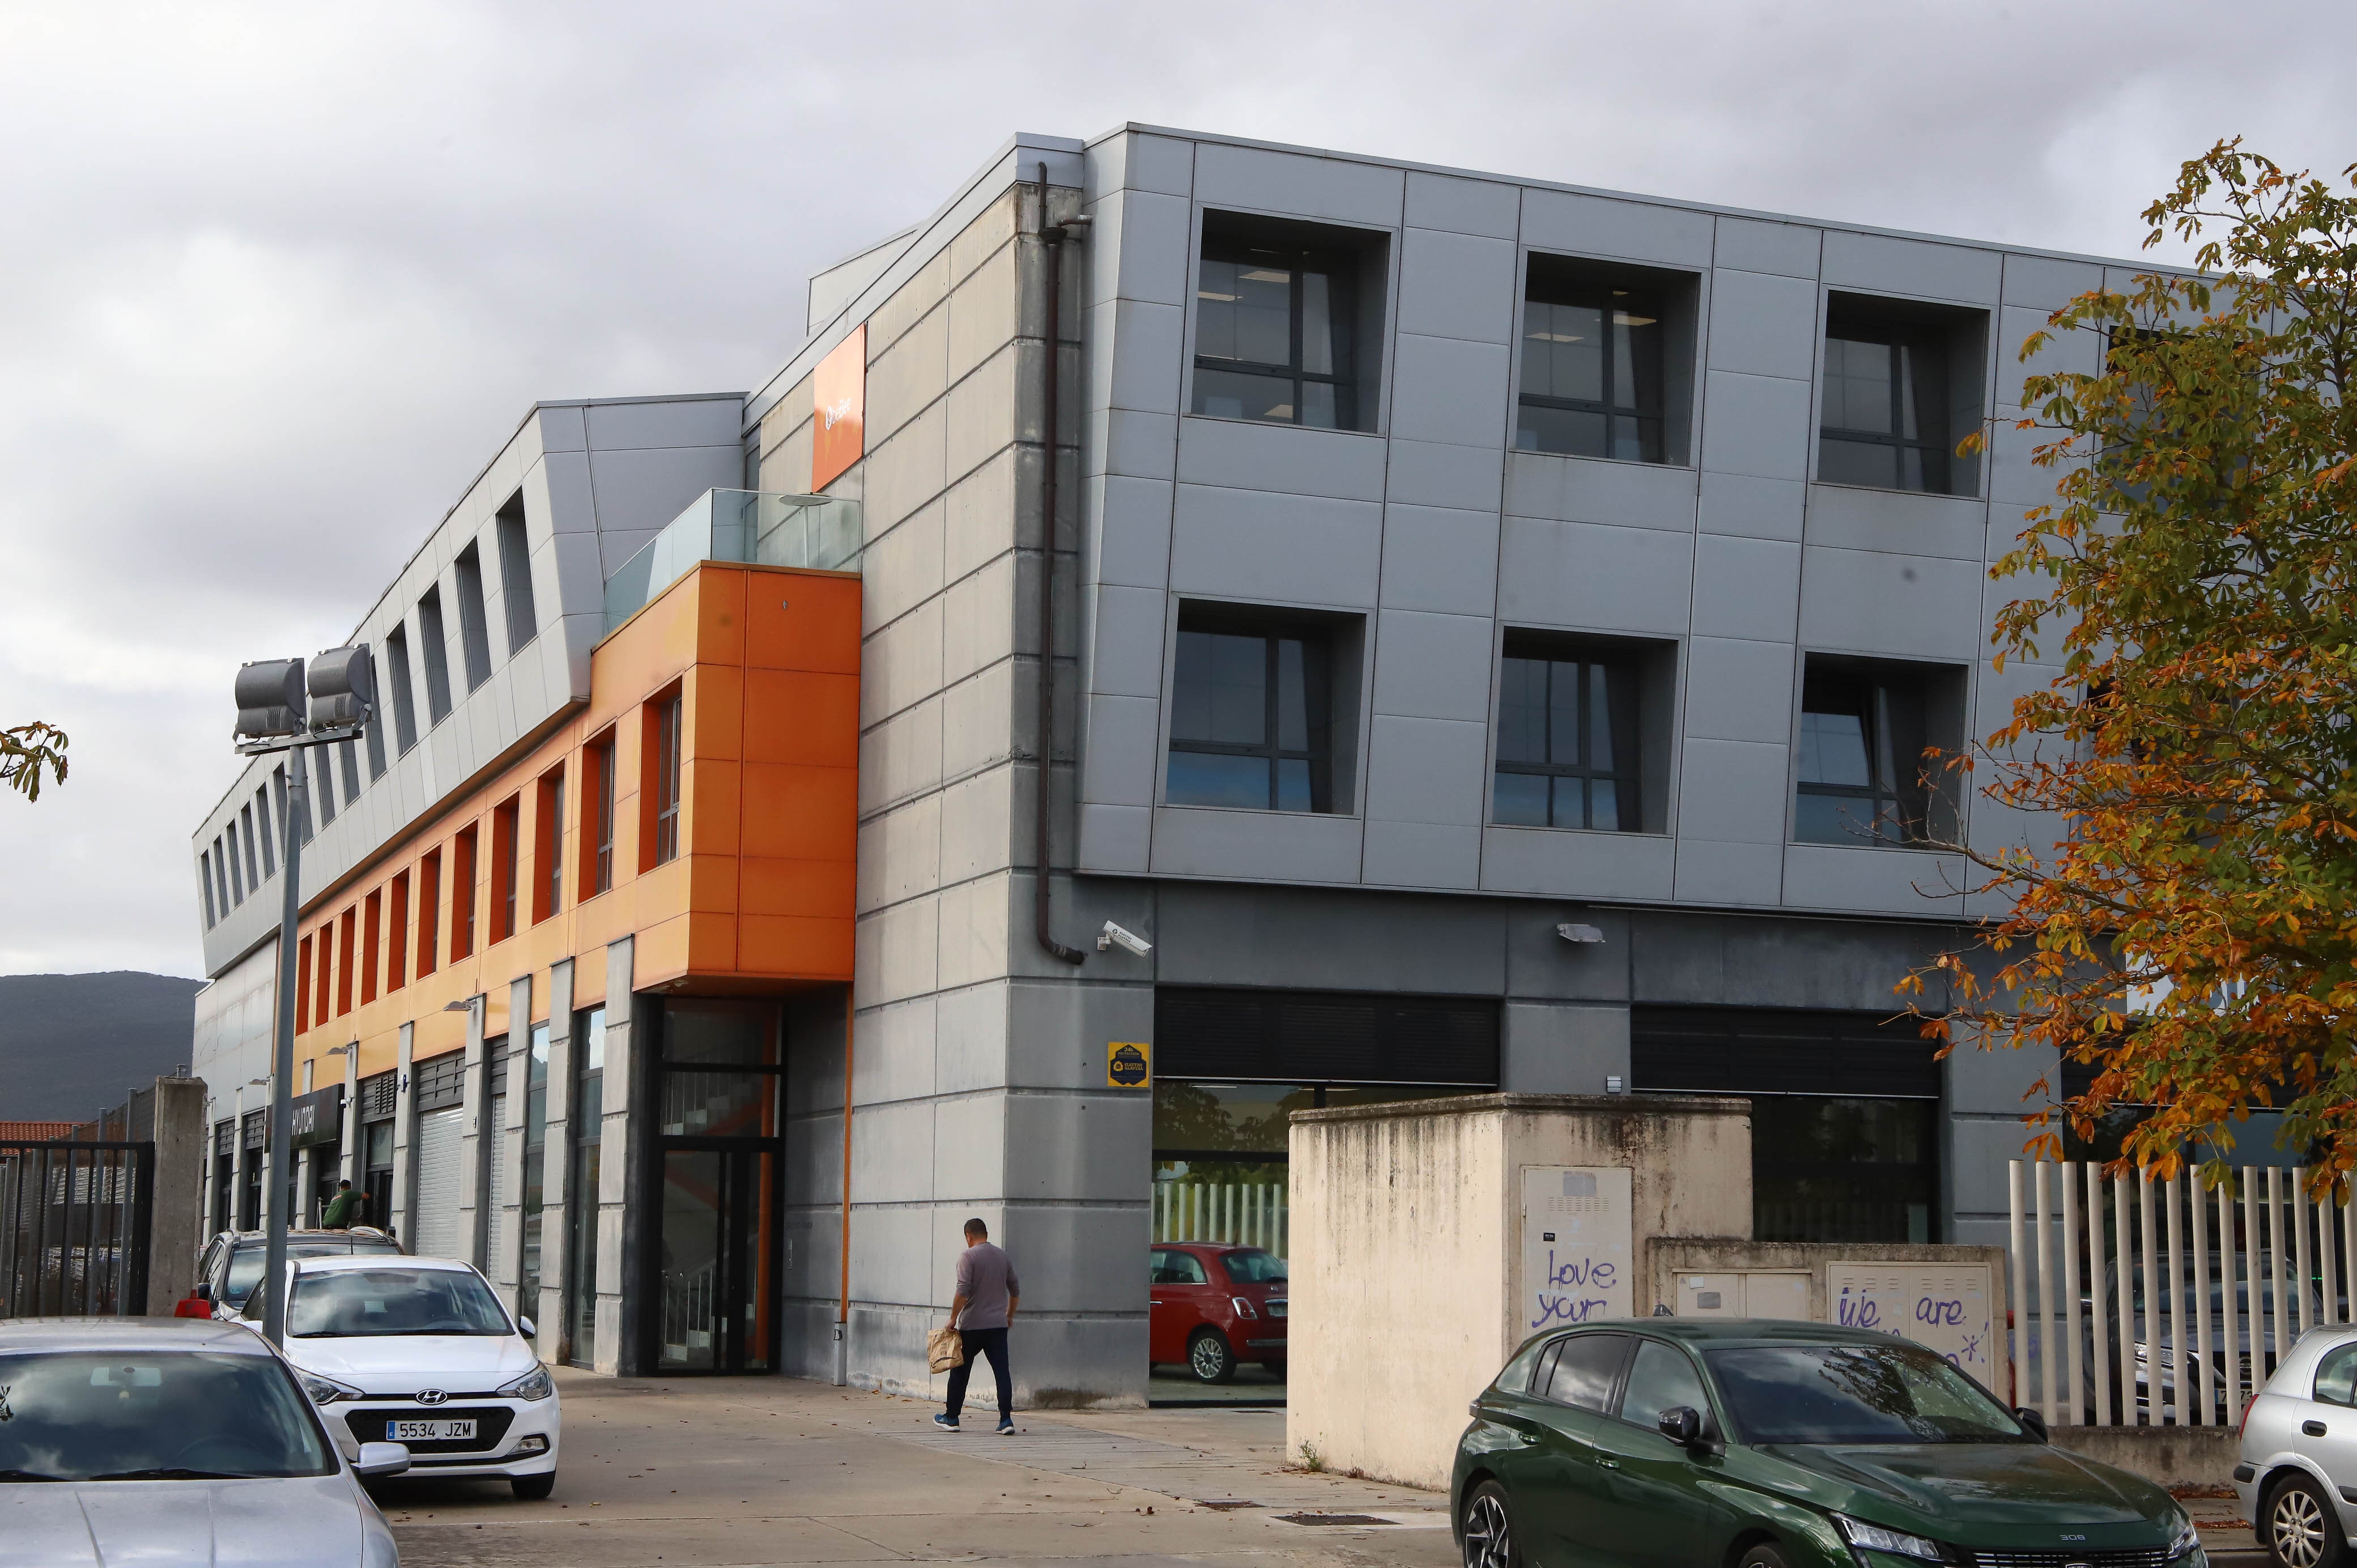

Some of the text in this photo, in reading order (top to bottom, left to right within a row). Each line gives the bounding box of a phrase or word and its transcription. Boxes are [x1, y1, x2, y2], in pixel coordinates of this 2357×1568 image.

[291, 1104, 315, 1136] HYUNDAI
[1548, 1250, 1616, 1289] Love
[1916, 1297, 1966, 1328] are
[399, 1423, 436, 1438] 5534
[445, 1422, 471, 1437] JZM
